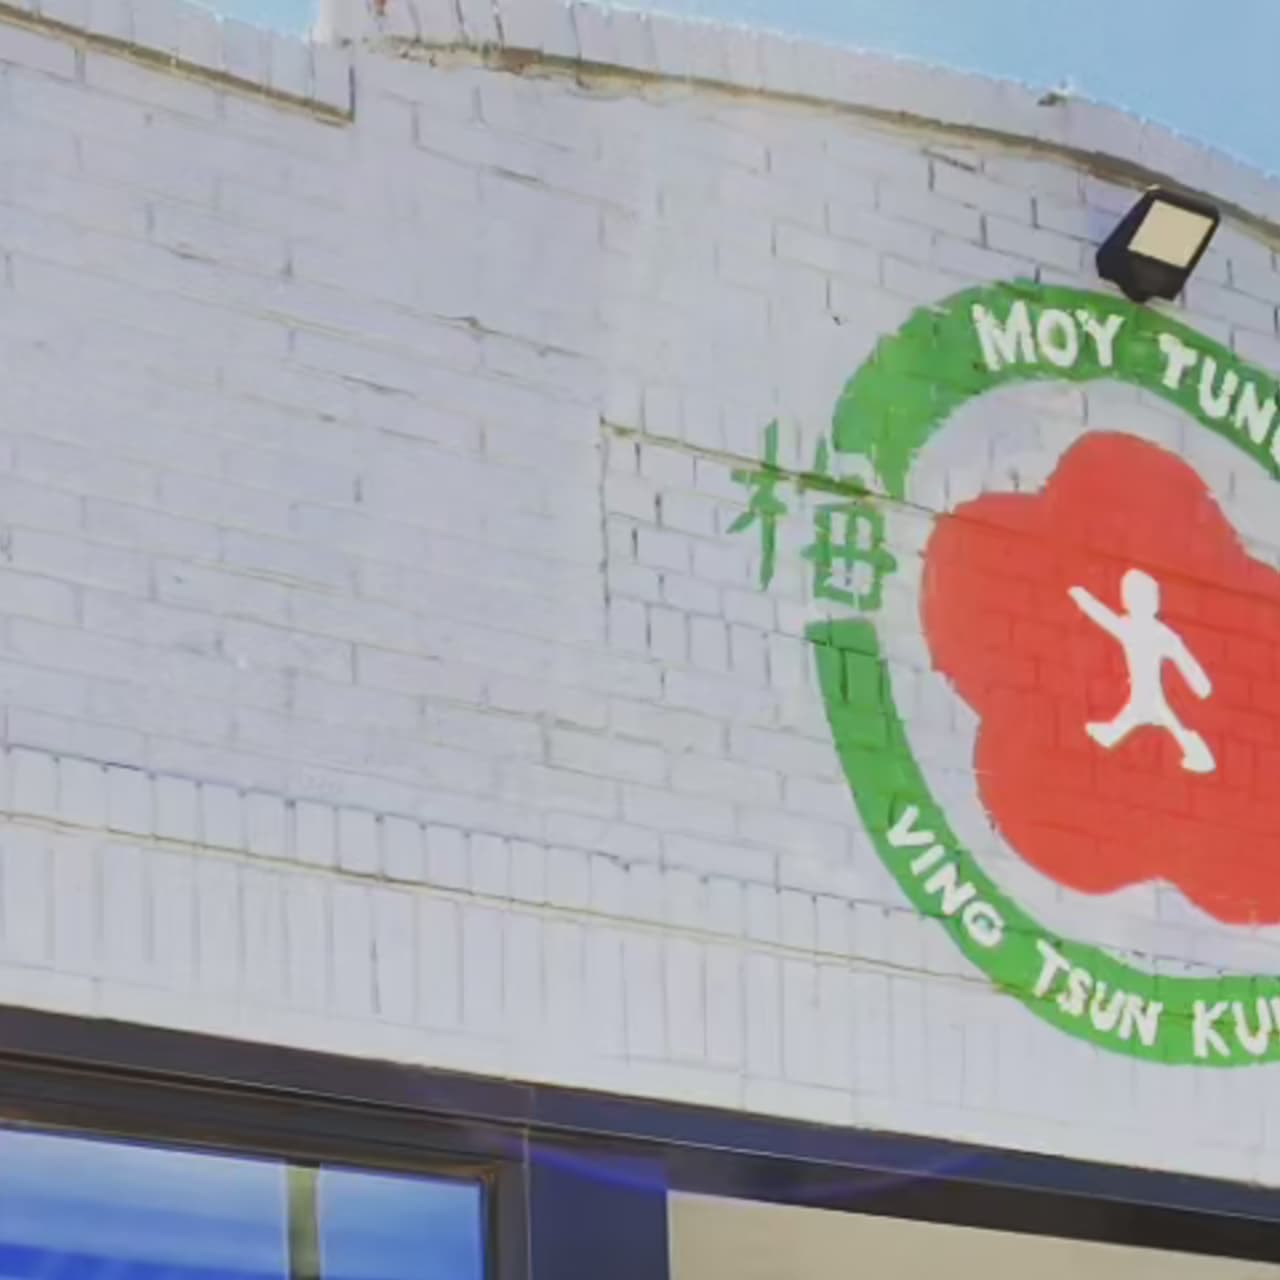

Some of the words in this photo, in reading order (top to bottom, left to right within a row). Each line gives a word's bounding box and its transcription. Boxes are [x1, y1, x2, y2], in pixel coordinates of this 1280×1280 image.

[972, 302, 1123, 371] MOY
[885, 806, 1003, 947] VING
[1031, 941, 1159, 1046] TSUN
